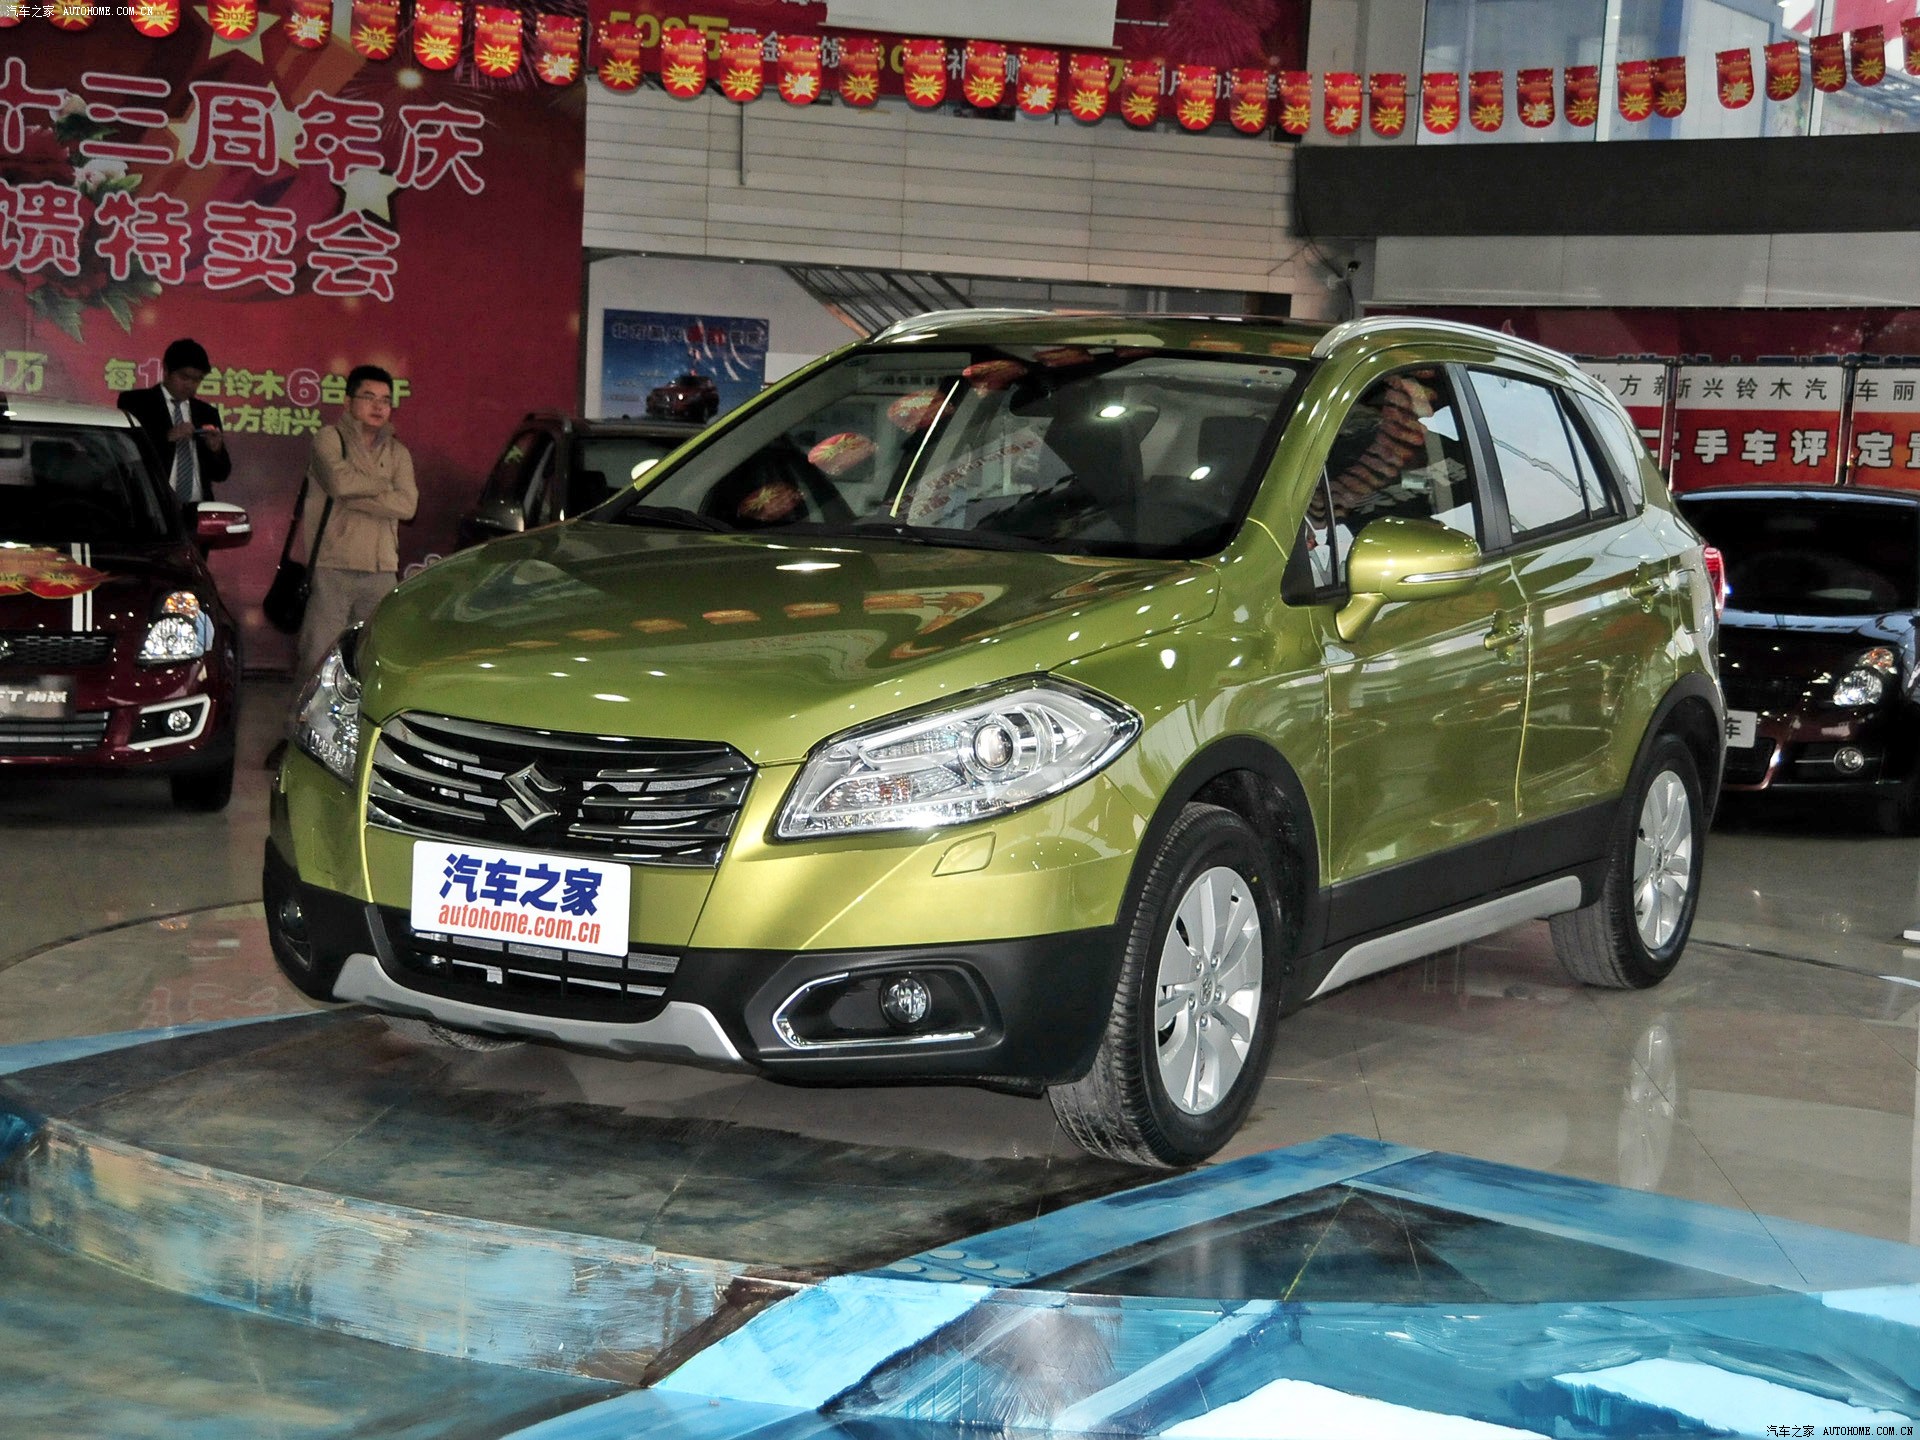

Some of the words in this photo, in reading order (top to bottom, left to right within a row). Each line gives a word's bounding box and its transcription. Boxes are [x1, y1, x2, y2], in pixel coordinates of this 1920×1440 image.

[0, 57, 485, 194] 十三周年庆
[0, 178, 400, 301] 馈特卖会
[438, 904, 601, 945] autohome.com.cn
[439, 853, 603, 917] 汽车之家
